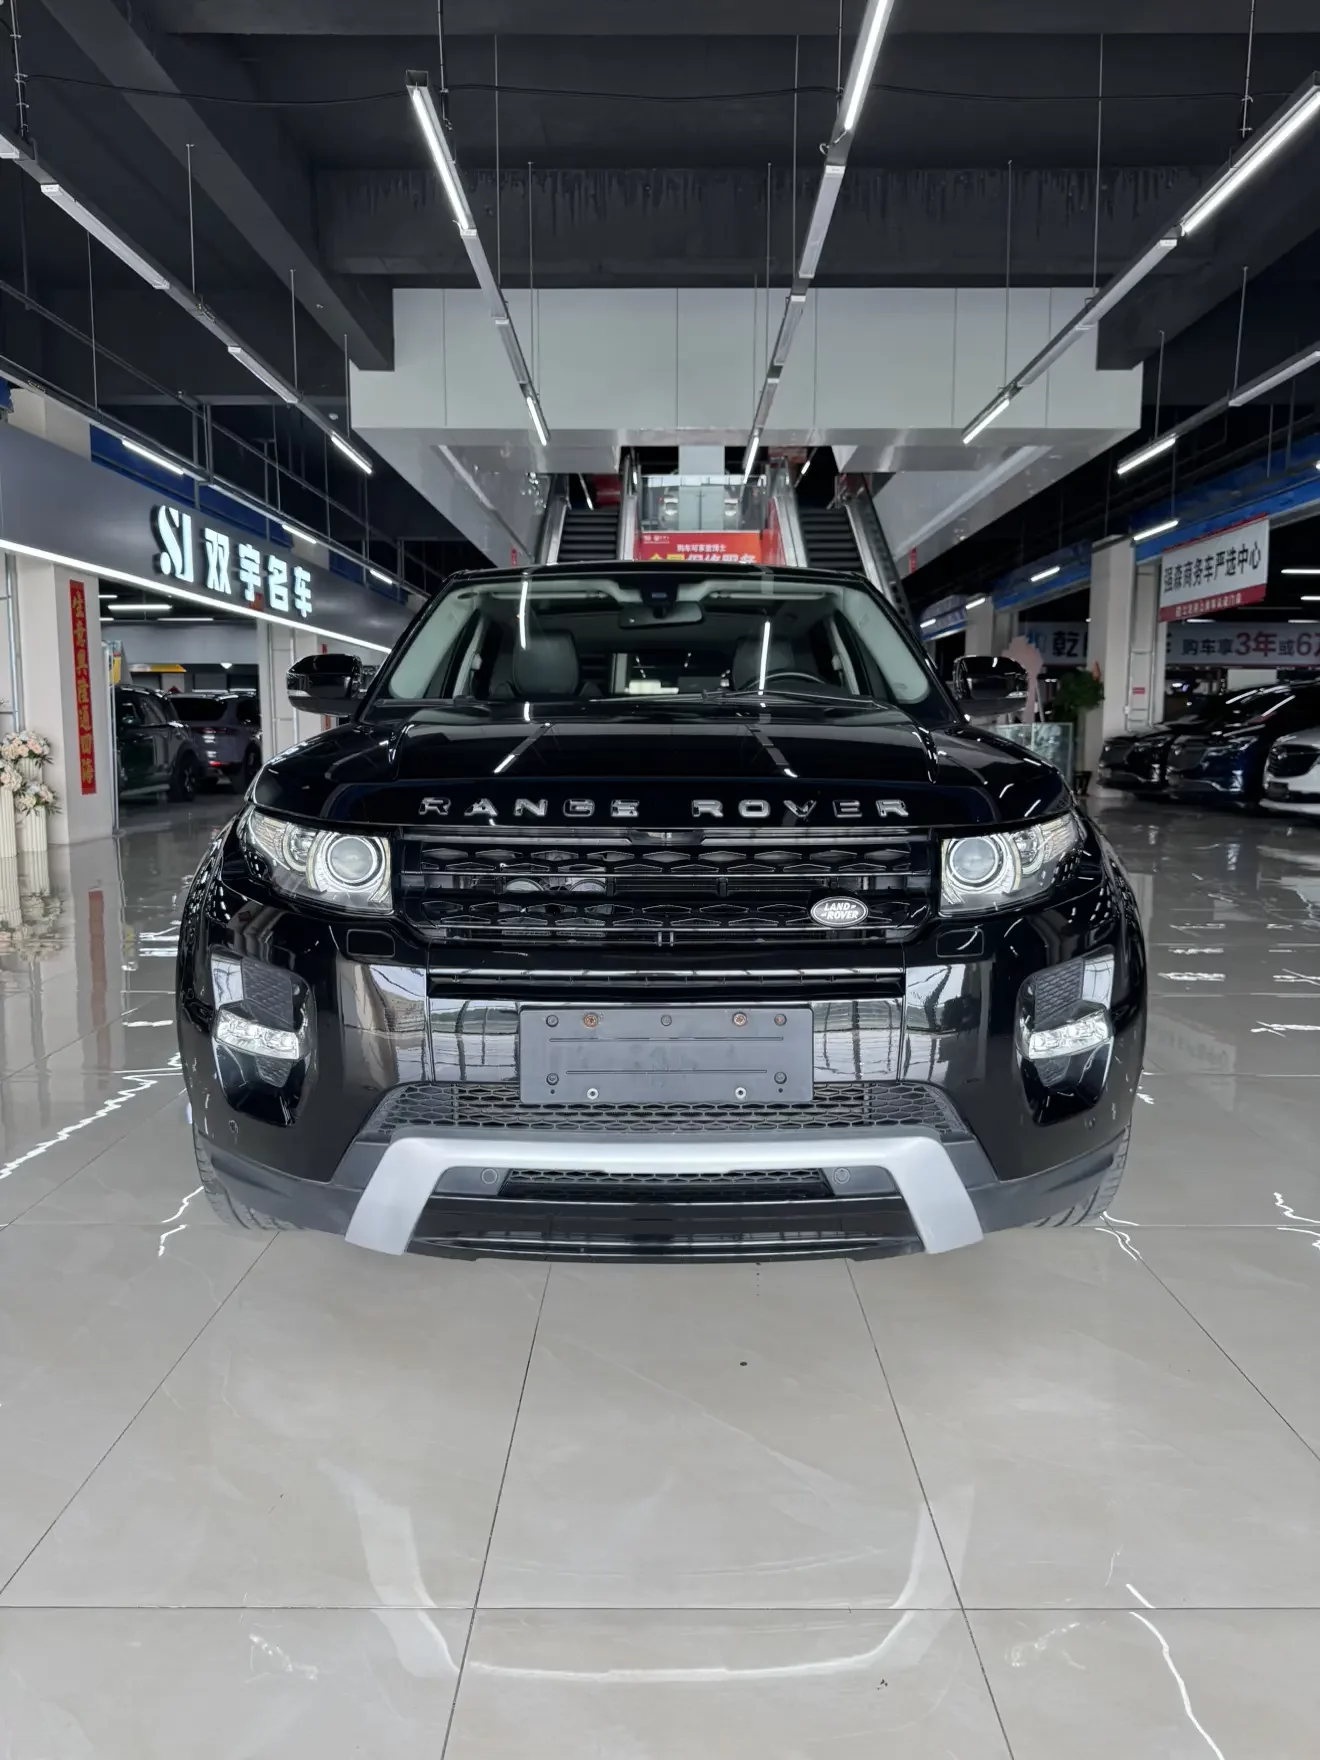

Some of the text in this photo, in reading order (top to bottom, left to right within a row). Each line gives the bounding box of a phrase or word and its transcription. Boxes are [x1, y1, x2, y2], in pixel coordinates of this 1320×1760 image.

[204, 528, 313, 618] 双宇名车
[418, 797, 909, 818] RANGE ROVER
[824, 902, 851, 911] LAND
[827, 910, 859, 920] ROVER
